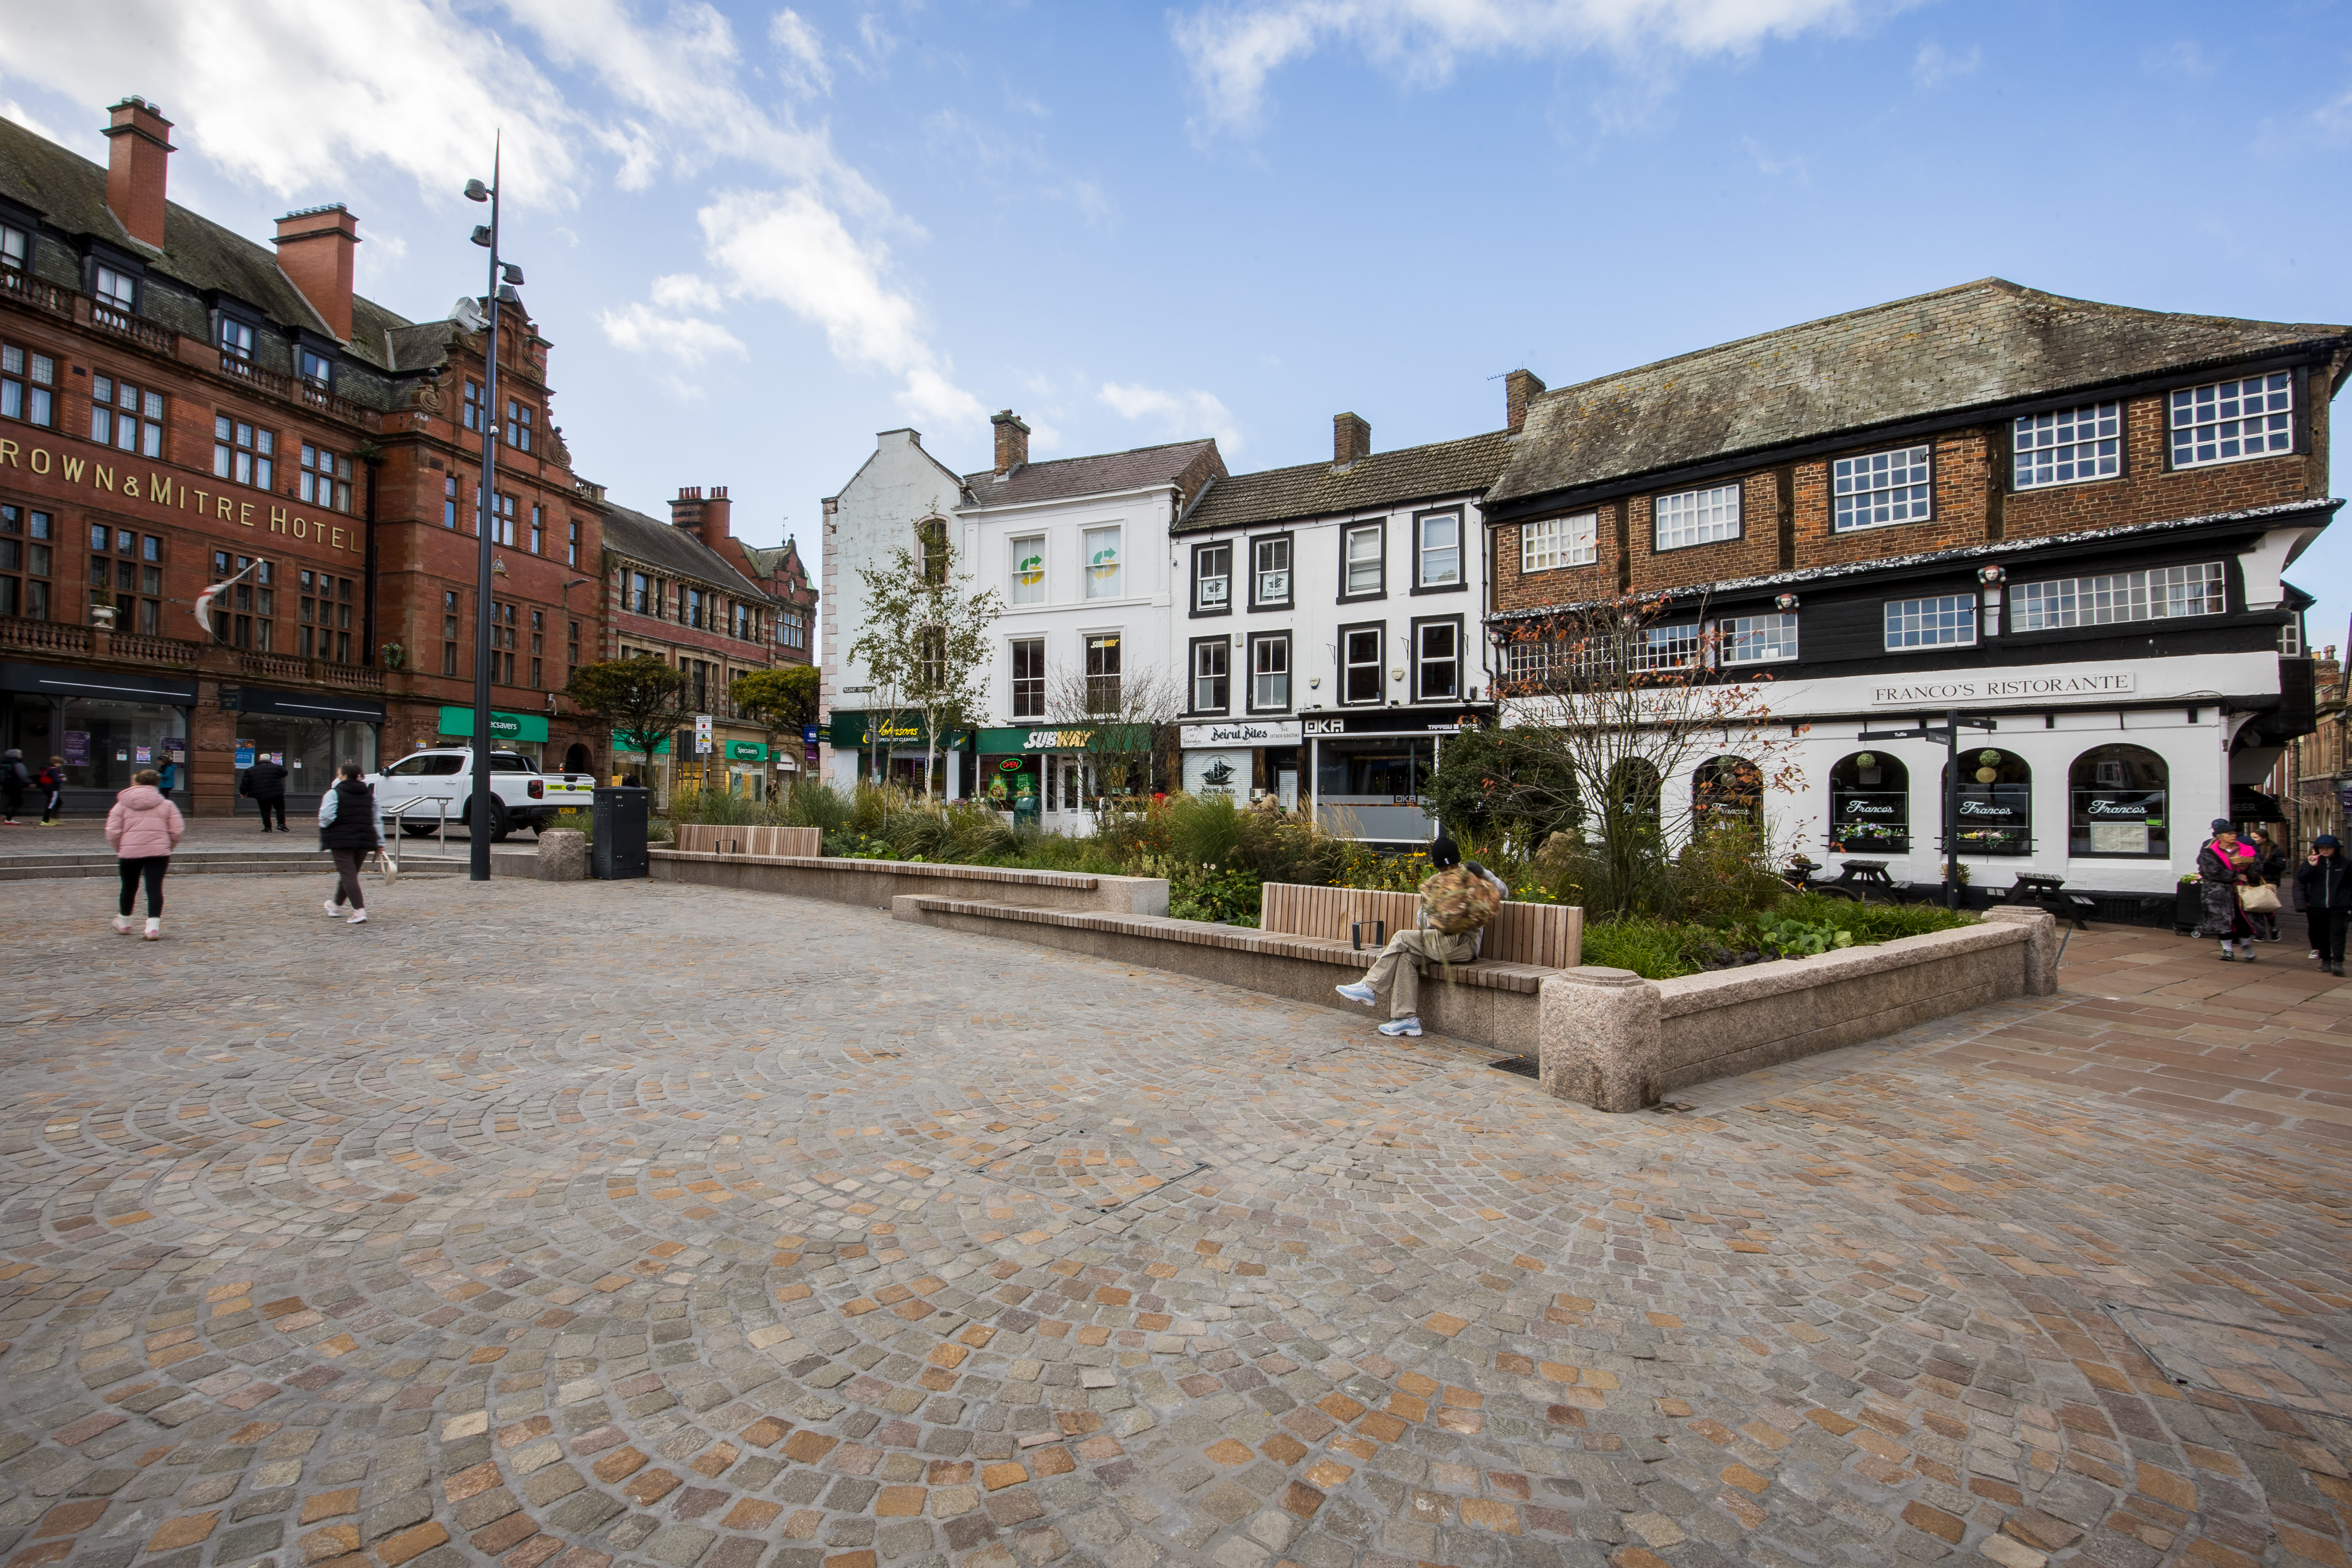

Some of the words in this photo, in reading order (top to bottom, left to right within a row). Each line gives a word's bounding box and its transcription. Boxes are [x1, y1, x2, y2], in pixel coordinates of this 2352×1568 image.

[123, 476, 140, 497] &
[150, 472, 255, 527] MITRE
[270, 505, 361, 553] HOTEL
[1090, 639, 1119, 649] SUBWAY
[1876, 684, 1975, 701] FRANCO'S
[1987, 675, 2129, 695] RISTORANTE
[490, 721, 517, 730] ecsavers
[1305, 718, 1344, 733] OKA
[1023, 730, 1095, 749] SUBWAY
[1211, 726, 1241, 741] Beirut
[1243, 725, 1268, 740] Bites
[737, 746, 757, 755] Specsavers
[1846, 800, 1894, 813] Franco's
[1959, 801, 2013, 815] Franco's
[2088, 800, 2148, 814] Franco's
